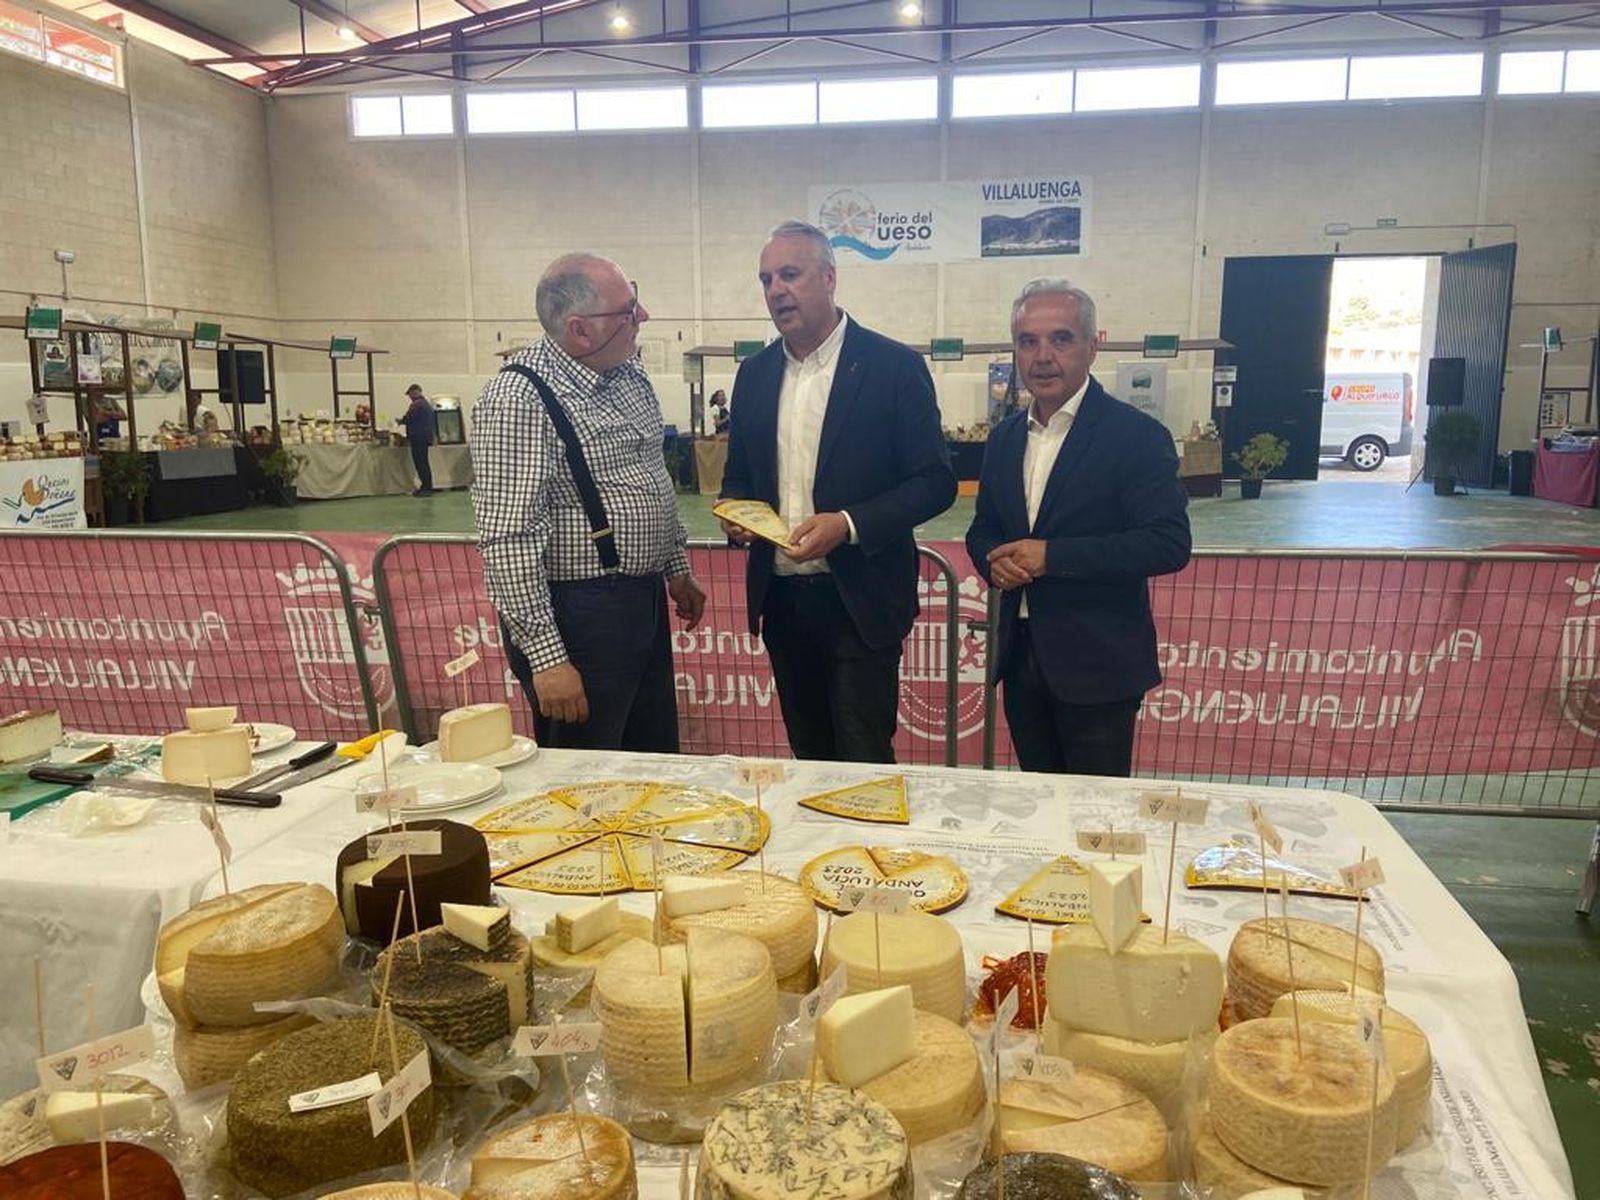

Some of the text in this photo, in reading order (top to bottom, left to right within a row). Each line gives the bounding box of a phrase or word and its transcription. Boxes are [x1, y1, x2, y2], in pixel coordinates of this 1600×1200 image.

[981, 180, 1082, 201] VILLALUENGA
[877, 212, 933, 224] feria del
[822, 865, 863, 874] 2023
[822, 874, 924, 888] ANDALUCIA
[1019, 897, 1088, 910] NDALUCIA
